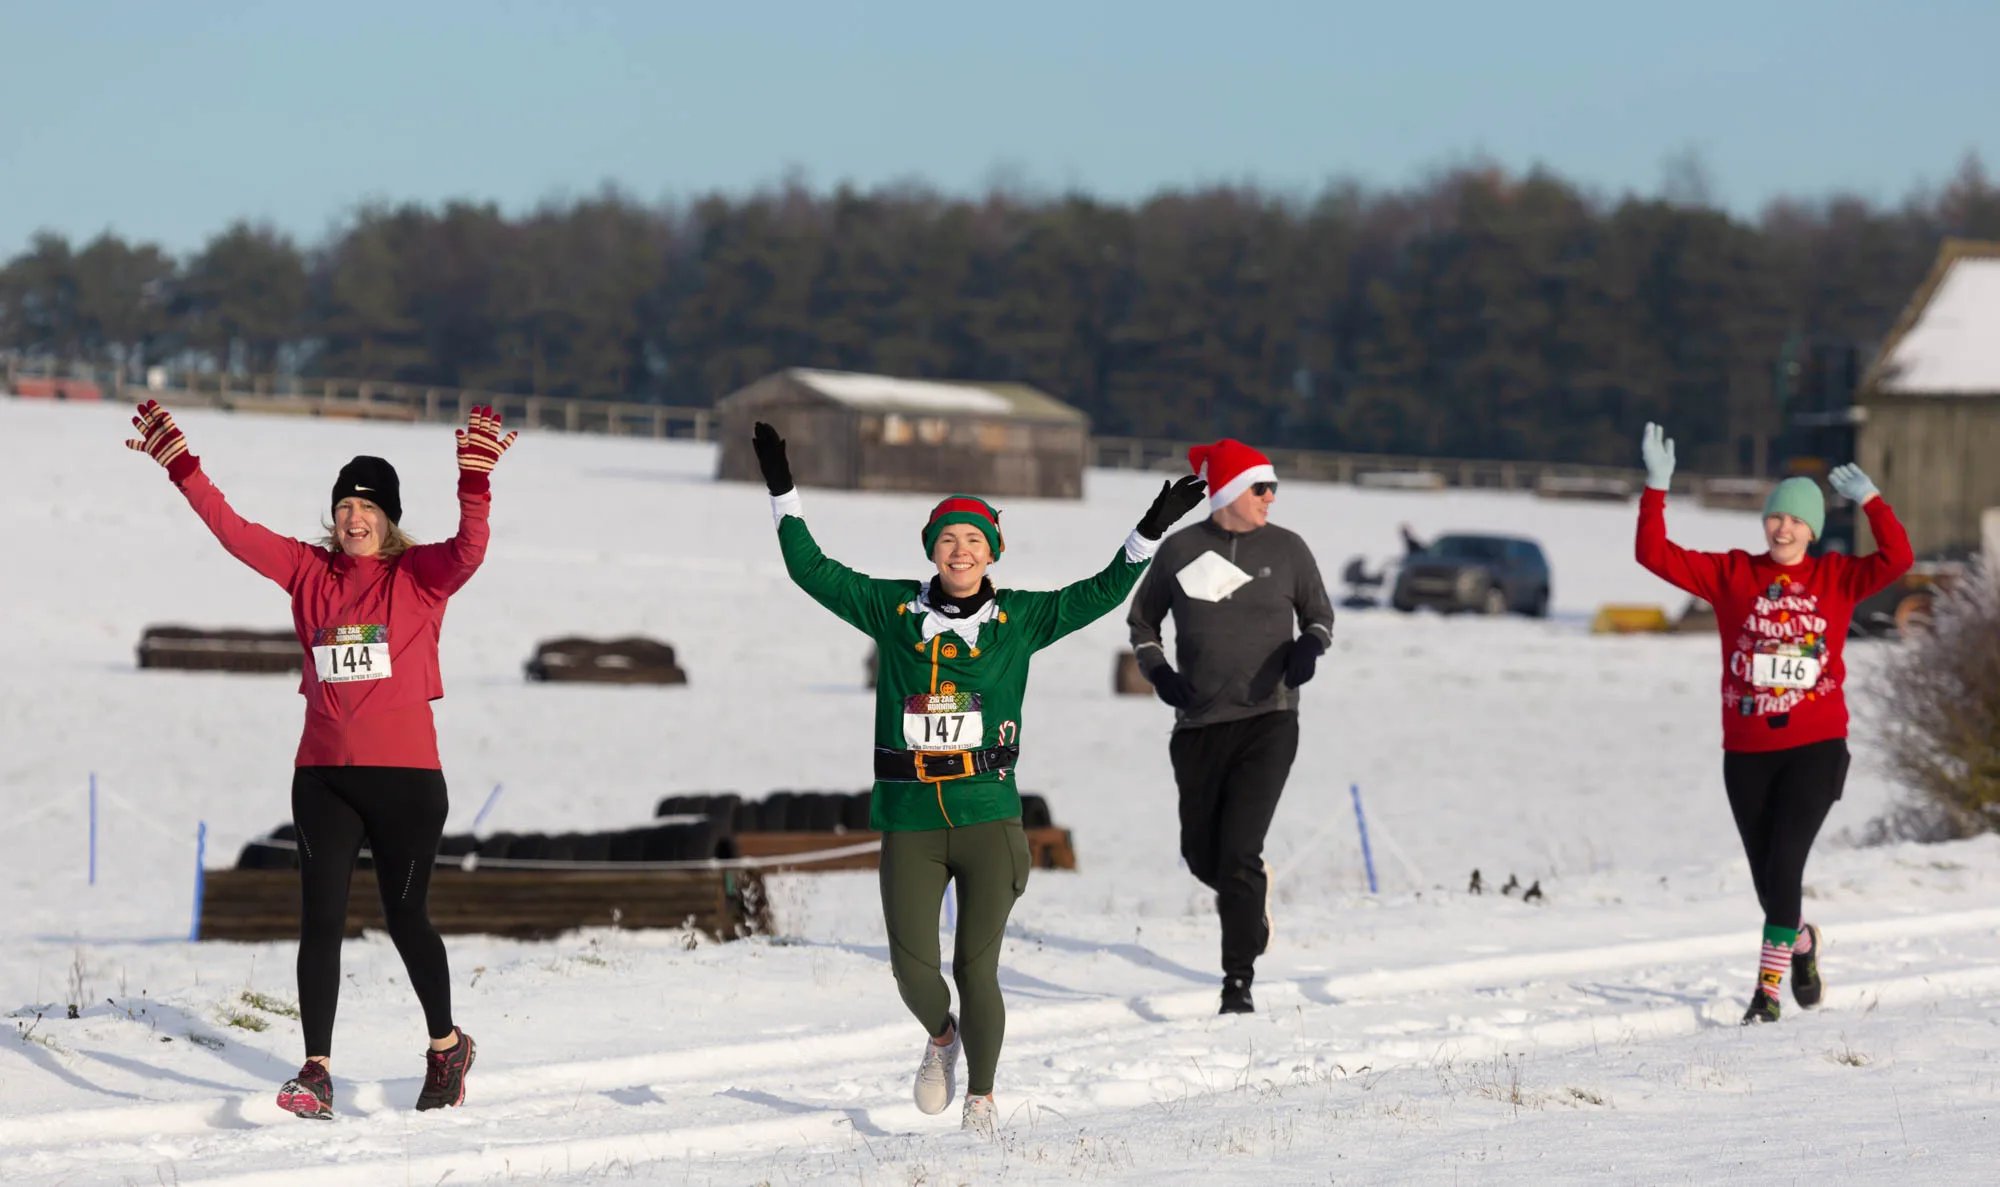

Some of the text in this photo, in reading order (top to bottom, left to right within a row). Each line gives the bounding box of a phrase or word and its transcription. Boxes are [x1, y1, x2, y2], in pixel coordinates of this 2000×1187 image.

[1743, 613, 1827, 638] AROUND
[331, 646, 373, 675] 144
[1771, 657, 1806, 681] 146
[924, 714, 965, 743] 147
